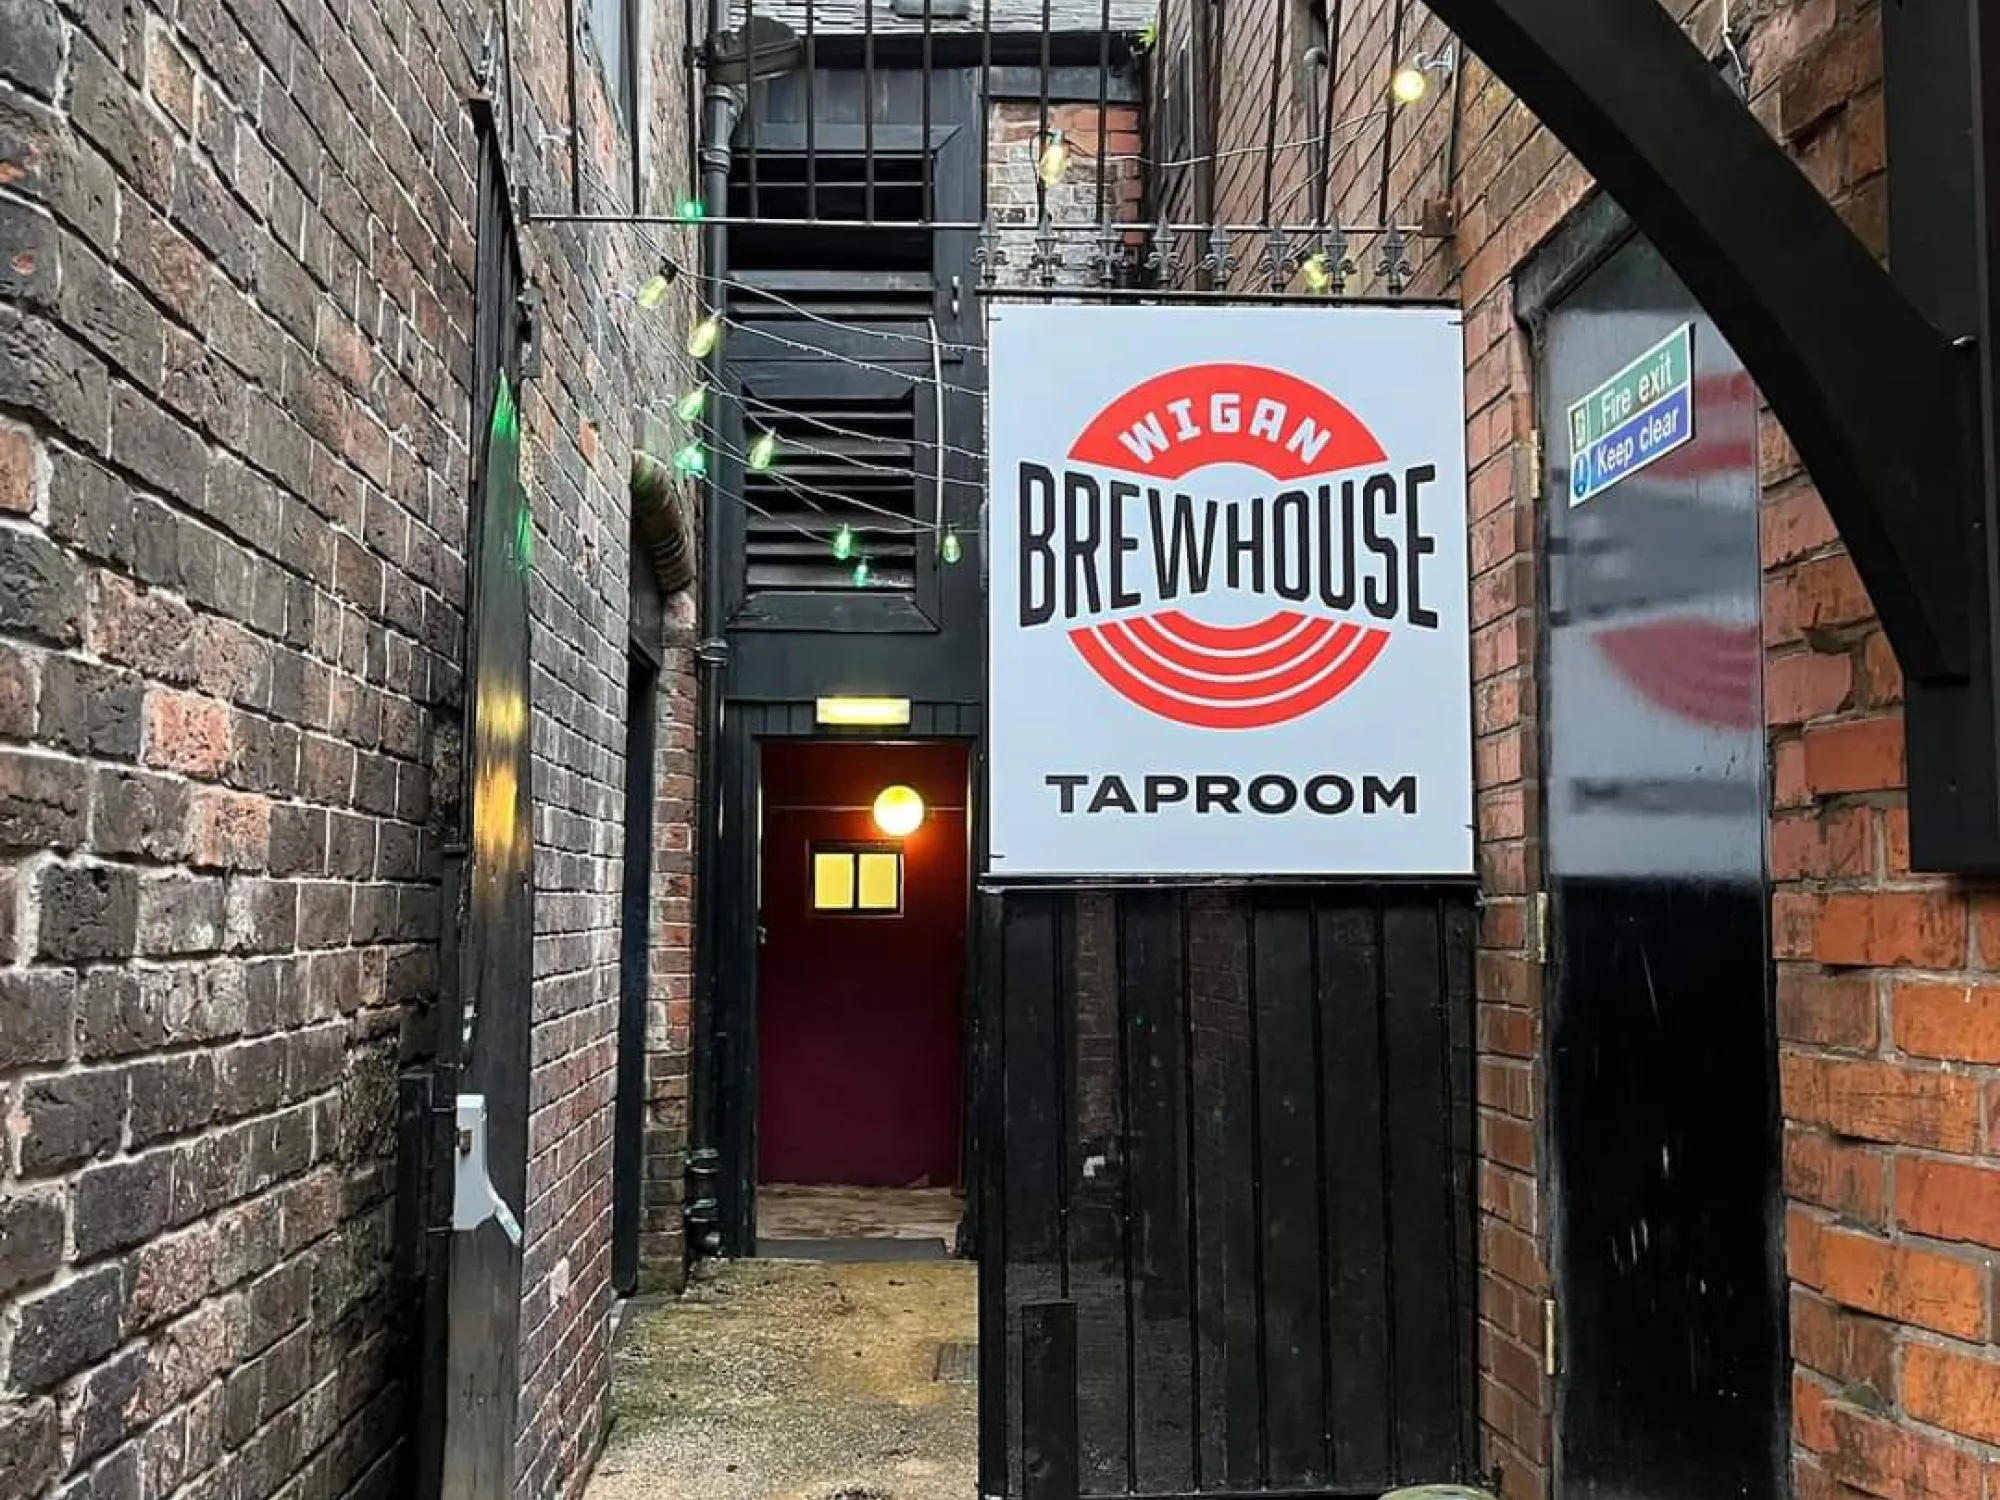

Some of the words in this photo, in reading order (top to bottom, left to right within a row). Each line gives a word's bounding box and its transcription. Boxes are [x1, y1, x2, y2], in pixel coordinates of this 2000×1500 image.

[1601, 387, 1632, 431] Fire
[1638, 351, 1673, 403] exit
[1118, 392, 1332, 466] WIGAN
[1597, 433, 1634, 478] Keep
[1638, 406, 1679, 451] clear
[1019, 460, 1438, 629] BREWHOUSE
[1045, 774, 1418, 815] TAPROOM
